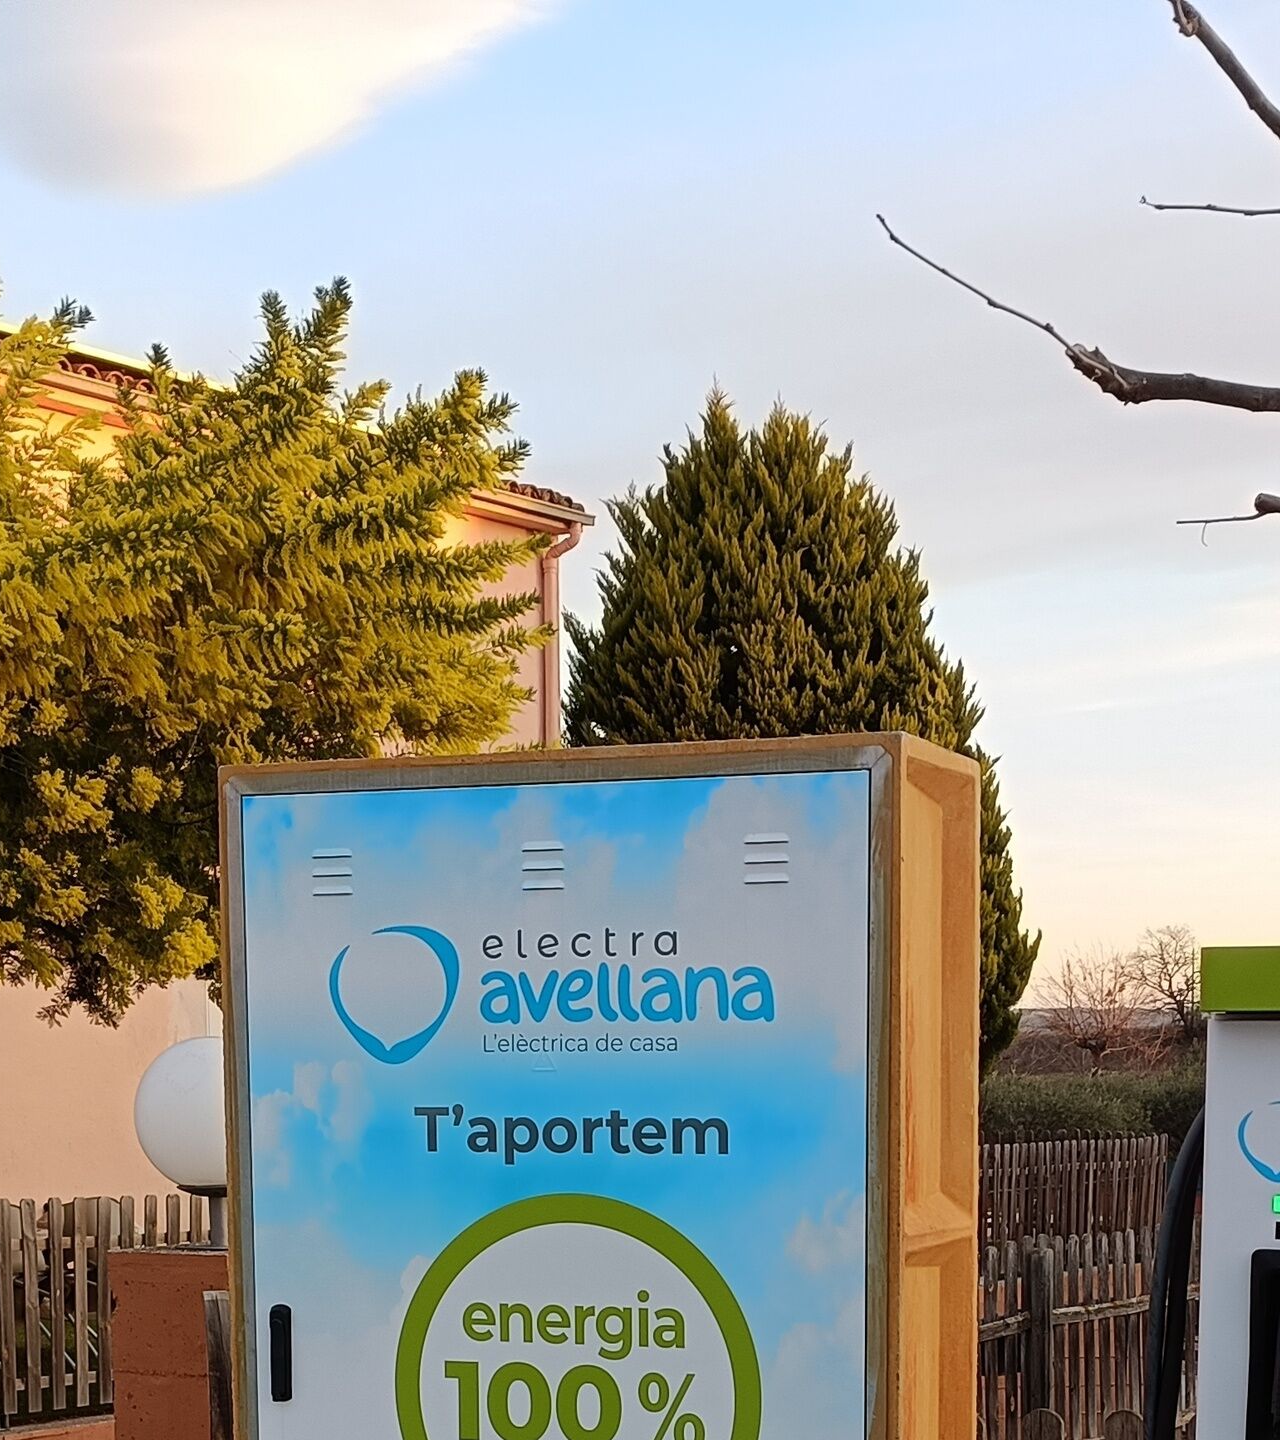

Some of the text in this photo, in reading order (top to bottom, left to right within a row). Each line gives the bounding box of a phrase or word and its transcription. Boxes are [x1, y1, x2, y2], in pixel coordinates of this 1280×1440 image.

[482, 928, 678, 959] electra
[480, 962, 775, 1024] avellana
[483, 1033, 678, 1052] L'elèctrica de casa
[414, 1104, 730, 1164] T'aportem
[463, 1290, 685, 1360] energia
